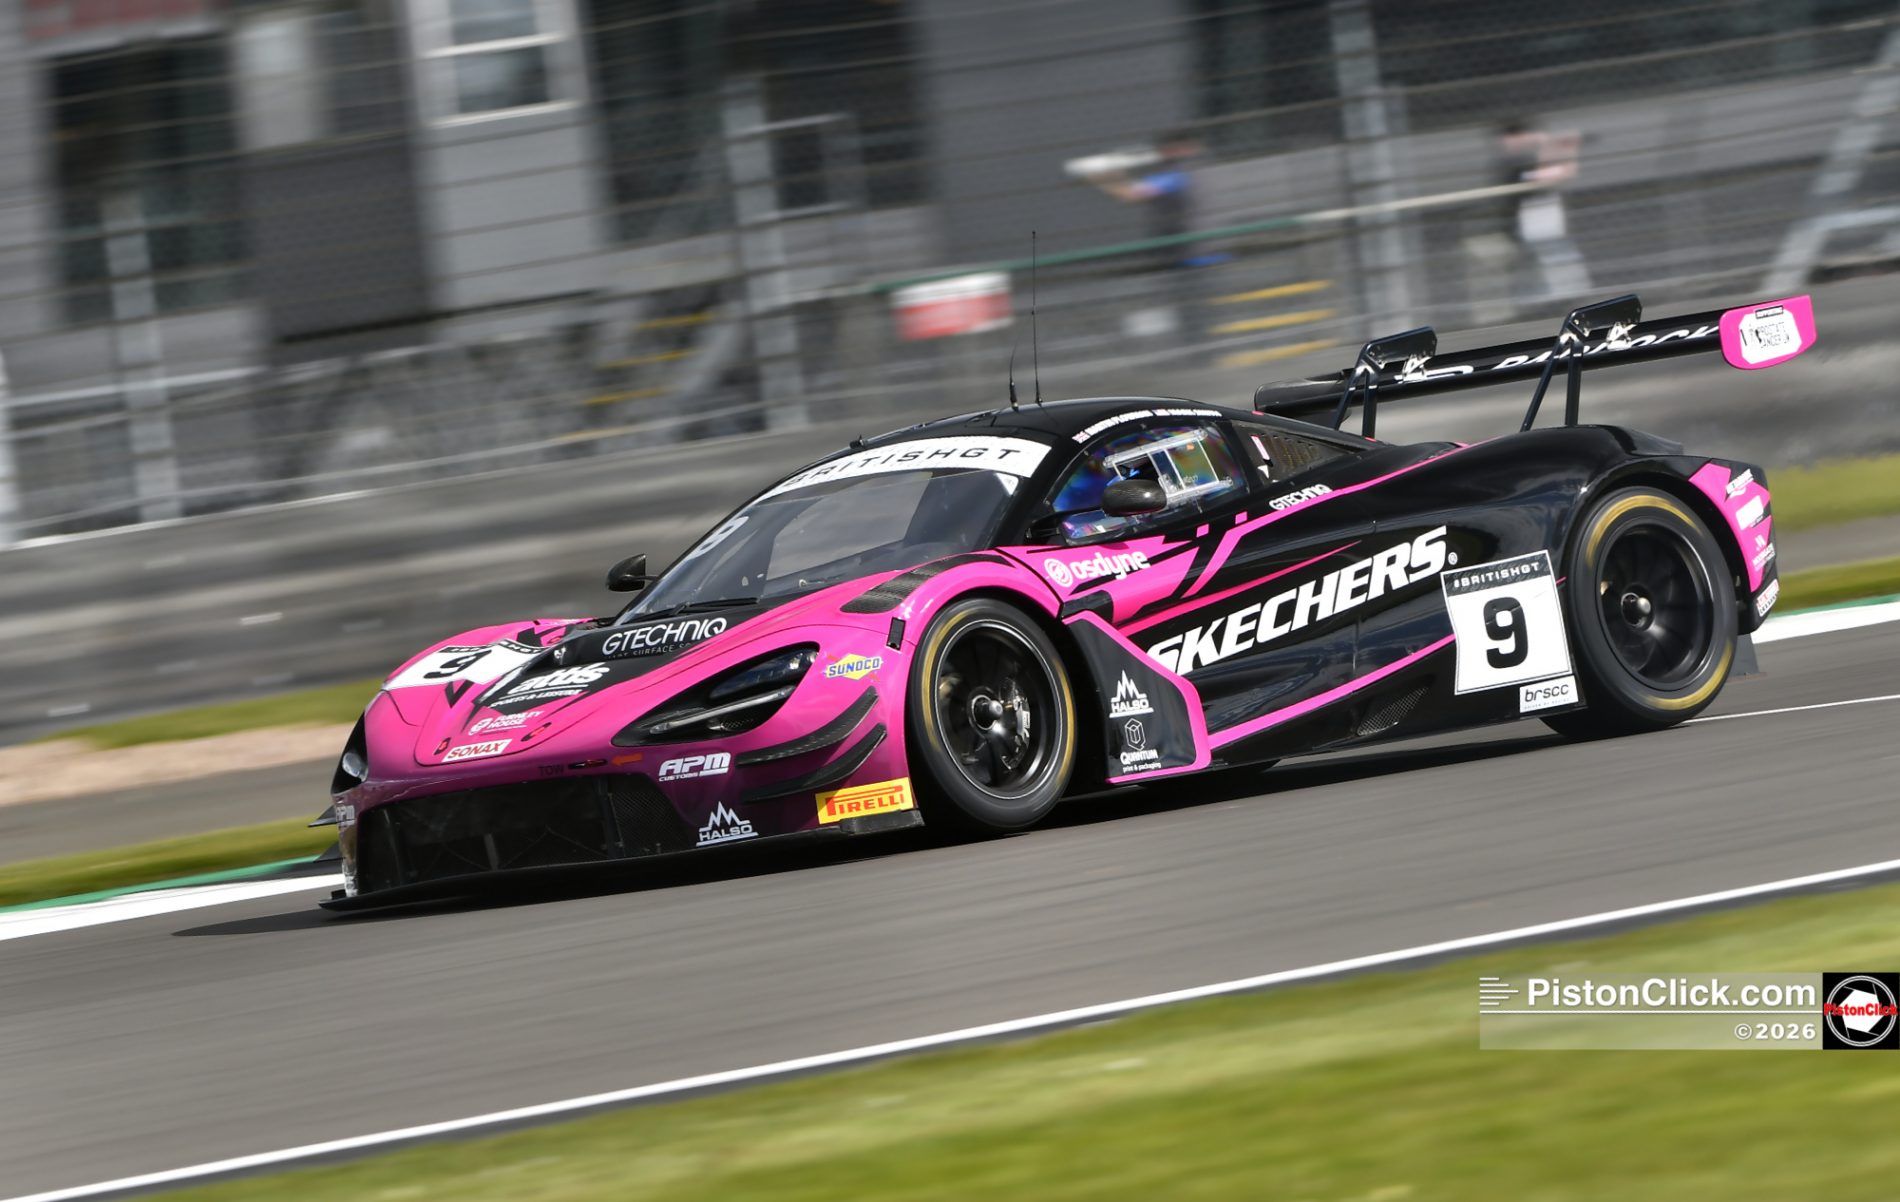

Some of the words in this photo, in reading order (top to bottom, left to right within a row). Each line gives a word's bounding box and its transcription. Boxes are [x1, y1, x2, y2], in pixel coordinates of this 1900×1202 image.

[1268, 483, 1333, 511] GTECHNIQ
[1069, 551, 1151, 580] osdyne
[1146, 525, 1447, 677] SKECHERS
[602, 617, 727, 655] GTECHNIQ
[1483, 596, 1528, 669] 9
[423, 649, 492, 679] 9
[828, 658, 881, 677] SUNOCO
[1111, 699, 1149, 713] HALSO
[1524, 684, 1569, 702] brscc
[447, 741, 505, 759] SONAX
[1120, 749, 1159, 765] QUANTUM
[658, 752, 731, 776] APM
[825, 784, 905, 816] PIRELLI
[699, 824, 753, 841] HALSO
